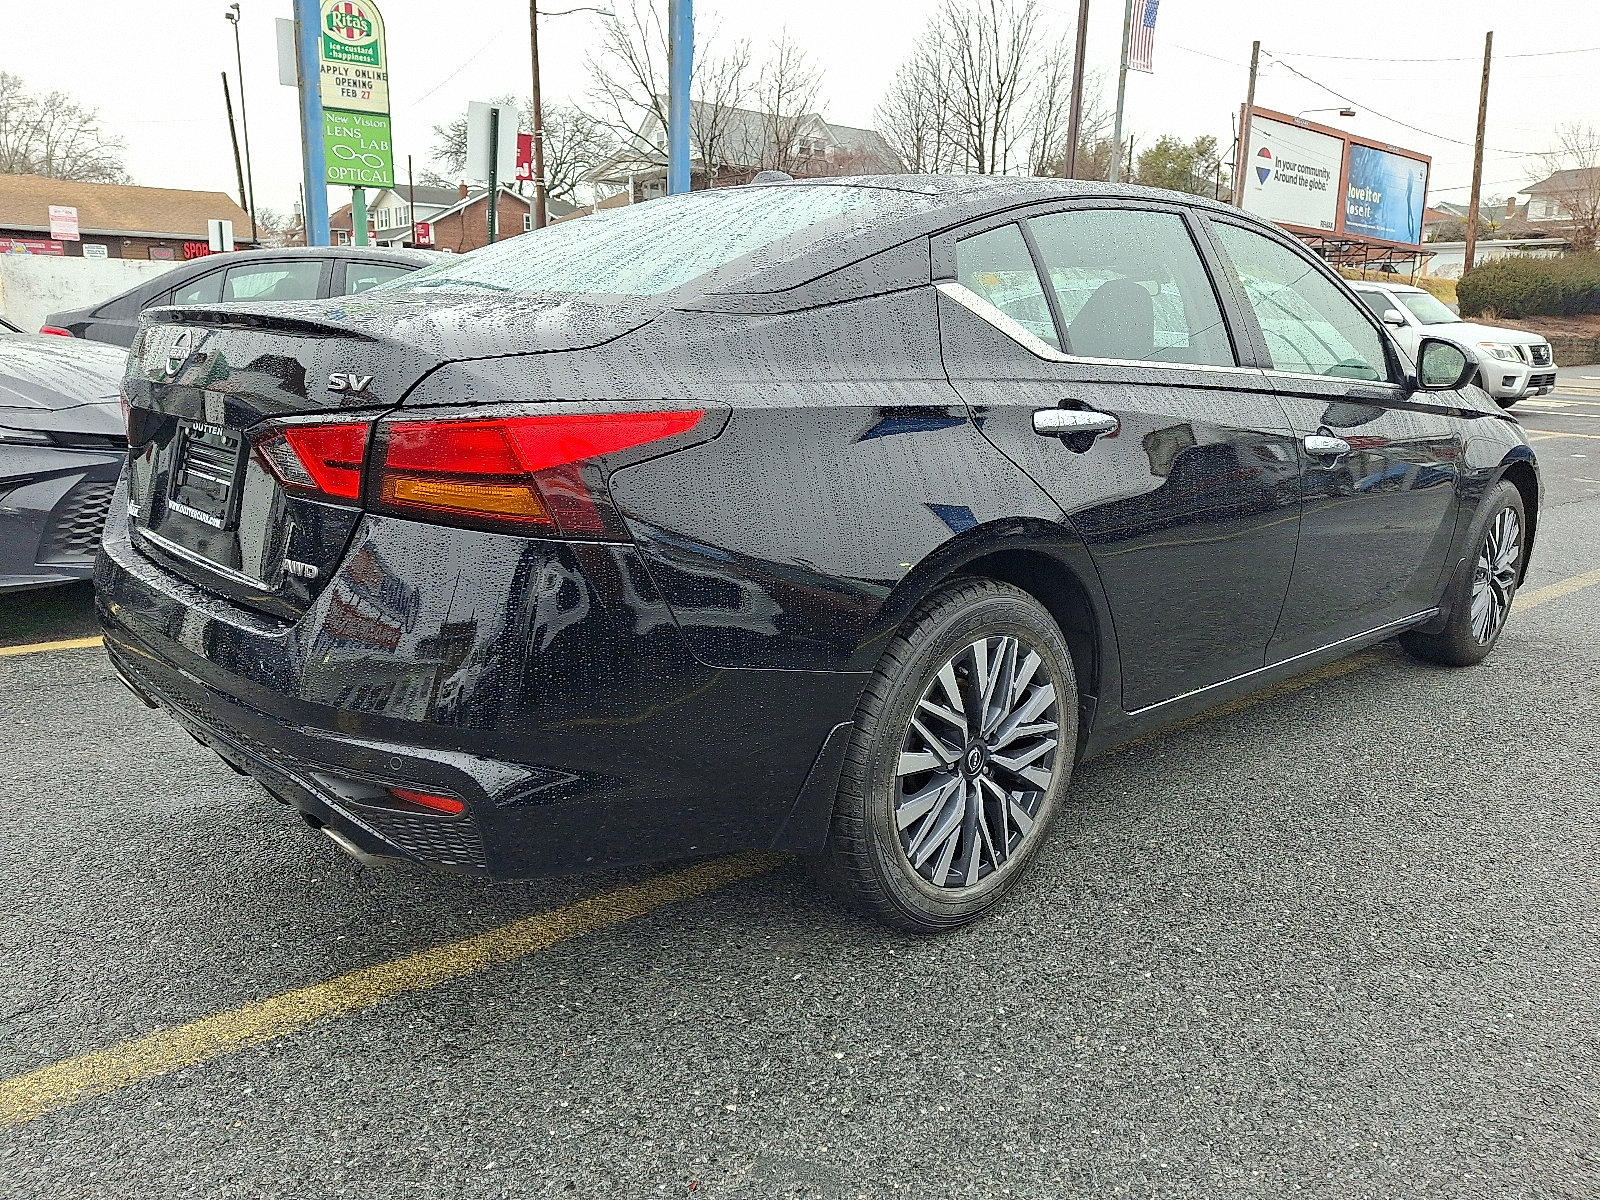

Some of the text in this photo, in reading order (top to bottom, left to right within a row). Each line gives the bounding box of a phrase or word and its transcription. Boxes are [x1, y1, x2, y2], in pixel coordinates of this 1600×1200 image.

[332, 10, 368, 31] Rita's
[332, 50, 371, 62] happiness
[344, 46, 373, 55] custard
[320, 64, 388, 81] APPLY ONLINE
[335, 77, 373, 90] OPENING
[341, 88, 371, 100] FEB 27
[326, 113, 386, 128] New Vision
[327, 125, 362, 139] LENS
[360, 139, 389, 151] LAB
[1275, 156, 1282, 168] In
[1282, 160, 1296, 172] your
[327, 166, 391, 183] OPTICAL
[1274, 170, 1298, 185] Around
[1298, 174, 1309, 188] the
[1365, 186, 1373, 202] it
[1372, 191, 1381, 203] or
[1346, 201, 1371, 217] lose it
[328, 372, 373, 392] SV
